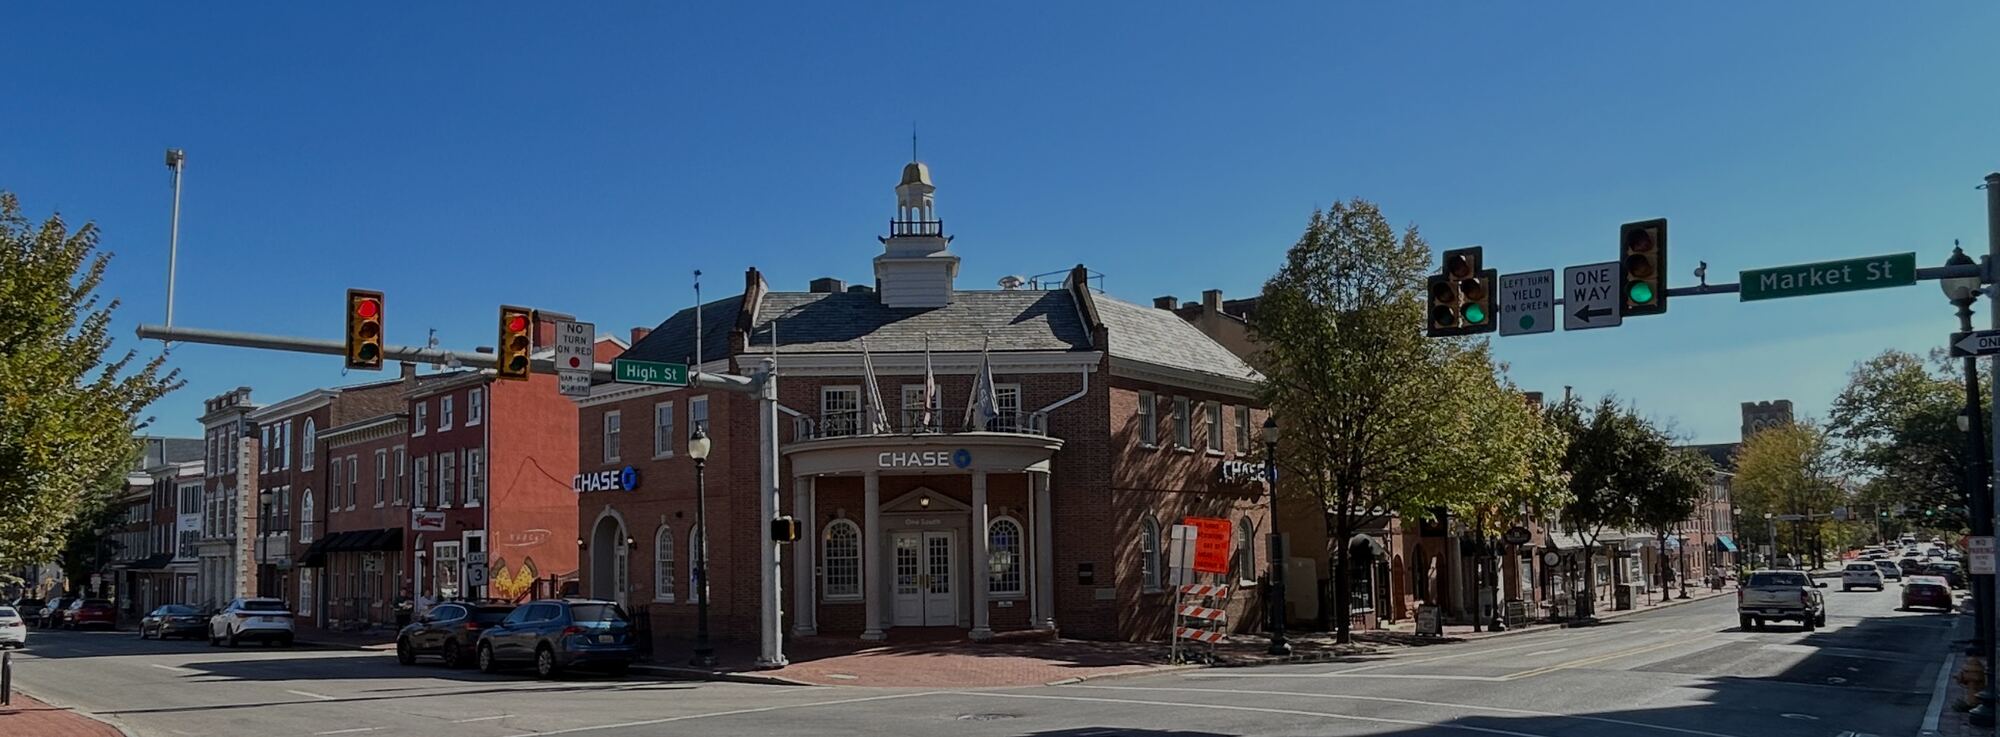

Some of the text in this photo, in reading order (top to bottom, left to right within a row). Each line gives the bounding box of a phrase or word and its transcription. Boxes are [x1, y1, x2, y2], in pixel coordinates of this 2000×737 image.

[1503, 275, 1550, 288] LEFT TURN
[1575, 268, 1610, 286] ONE
[1760, 260, 1892, 291] Market St
[1512, 288, 1541, 300] YIELD
[1574, 285, 1611, 302] WAY
[1505, 301, 1549, 313] ON GREEN
[567, 323, 583, 334] NO
[563, 335, 586, 345] TURN
[1979, 337, 2000, 348] ON
[557, 345, 592, 356] ON RED
[626, 364, 677, 382] High St
[879, 452, 950, 467] CHASE
[1223, 460, 1266, 481] CHASE
[573, 470, 620, 492] CHASE
[474, 569, 483, 582] 3
